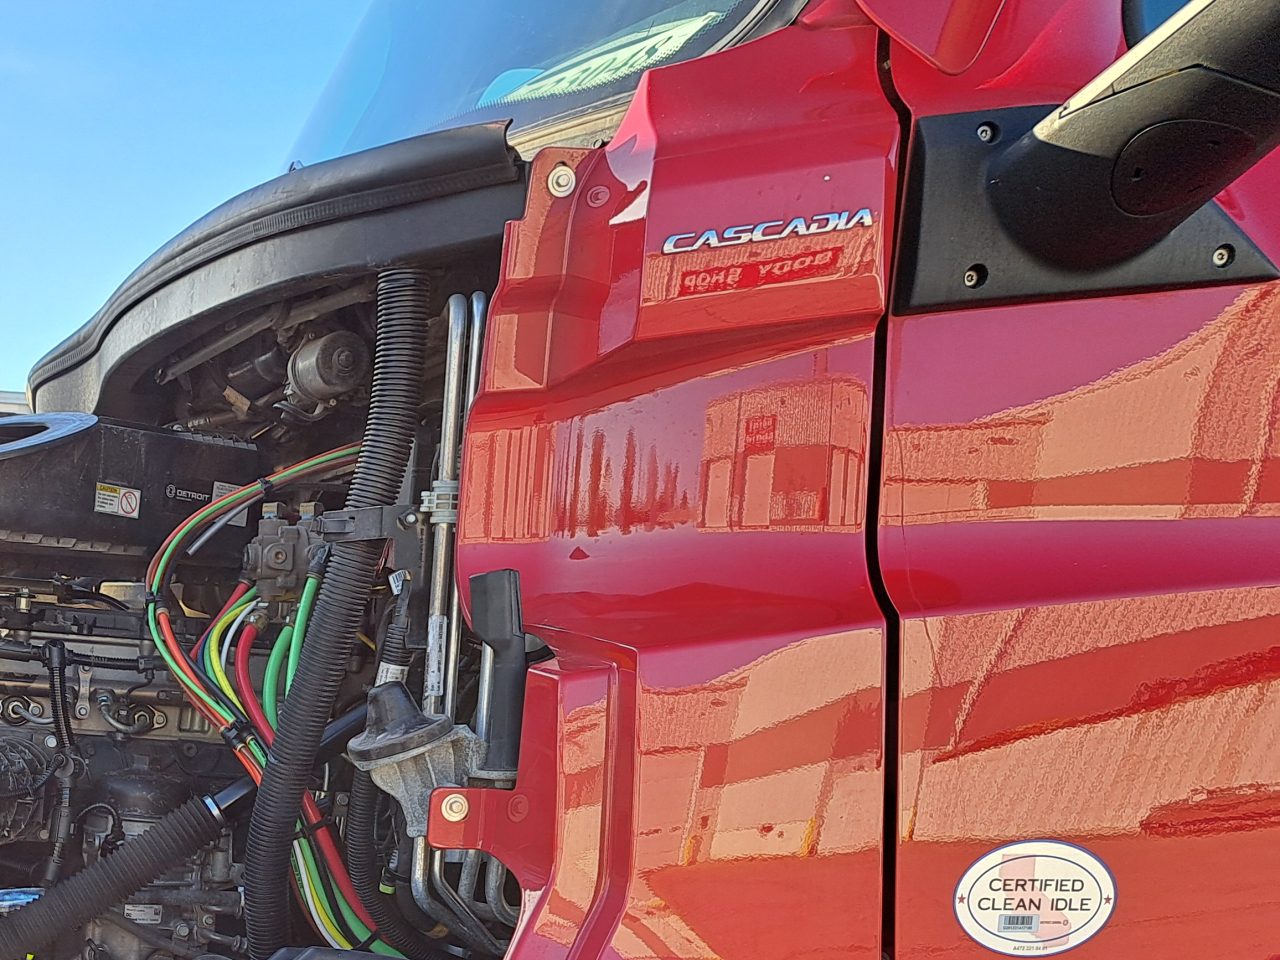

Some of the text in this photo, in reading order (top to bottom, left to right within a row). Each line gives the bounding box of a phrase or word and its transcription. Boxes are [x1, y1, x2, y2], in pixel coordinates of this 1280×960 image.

[662, 208, 874, 254] CASCADIA
[176, 489, 211, 502] DETROIT
[988, 878, 1085, 892] CERTIFIED
[977, 897, 1092, 911] CLEAN IDLE
